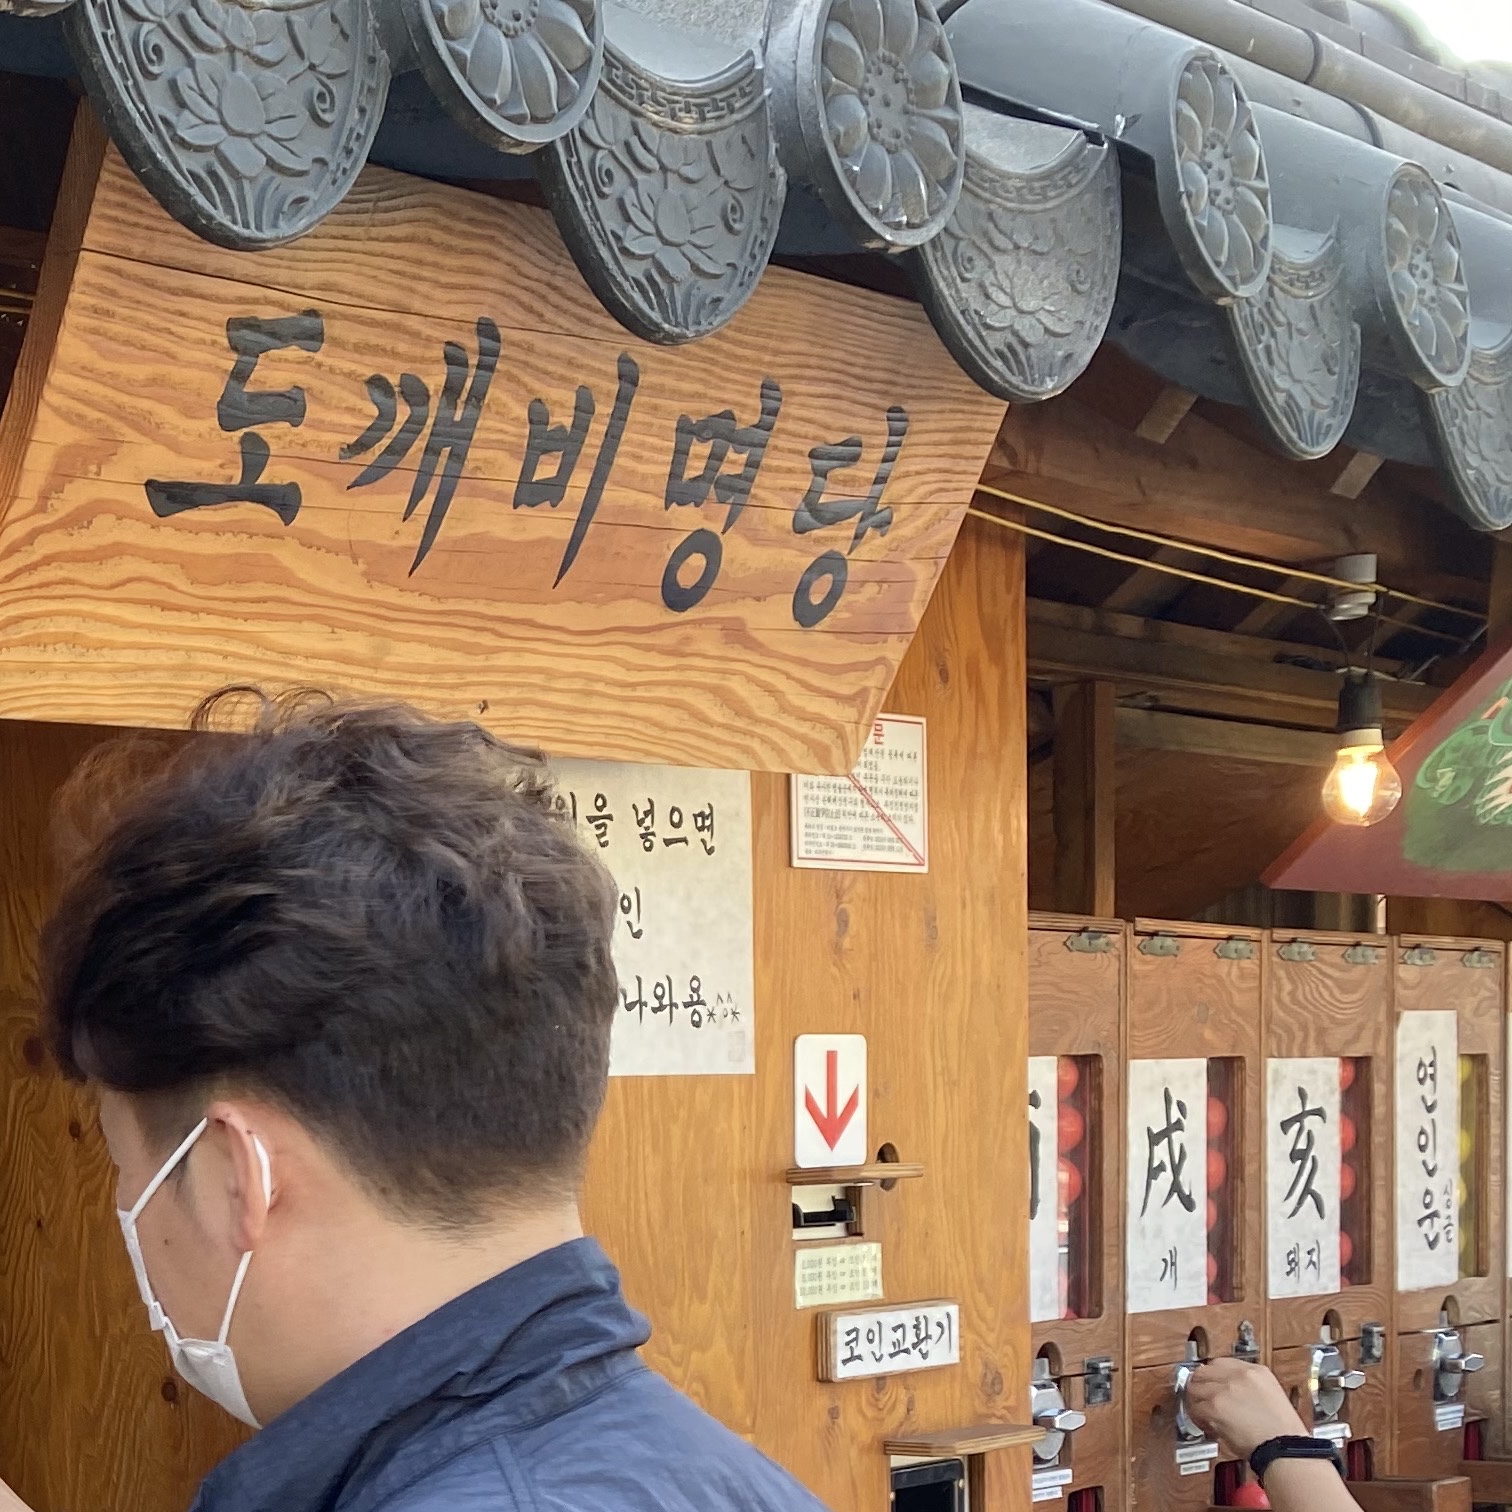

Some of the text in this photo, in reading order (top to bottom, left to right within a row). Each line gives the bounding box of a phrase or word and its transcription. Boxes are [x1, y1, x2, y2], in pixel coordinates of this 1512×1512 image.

[145, 308, 909, 628] 도깨비명당
[632, 798, 715, 856] 넣으면
[1139, 1086, 1197, 1218] 戌
[1279, 1085, 1327, 1221] 亥
[1416, 1045, 1440, 1251] 연인운
[1159, 1245, 1178, 1291] 개
[840, 1311, 953, 1367] 코인교환기
